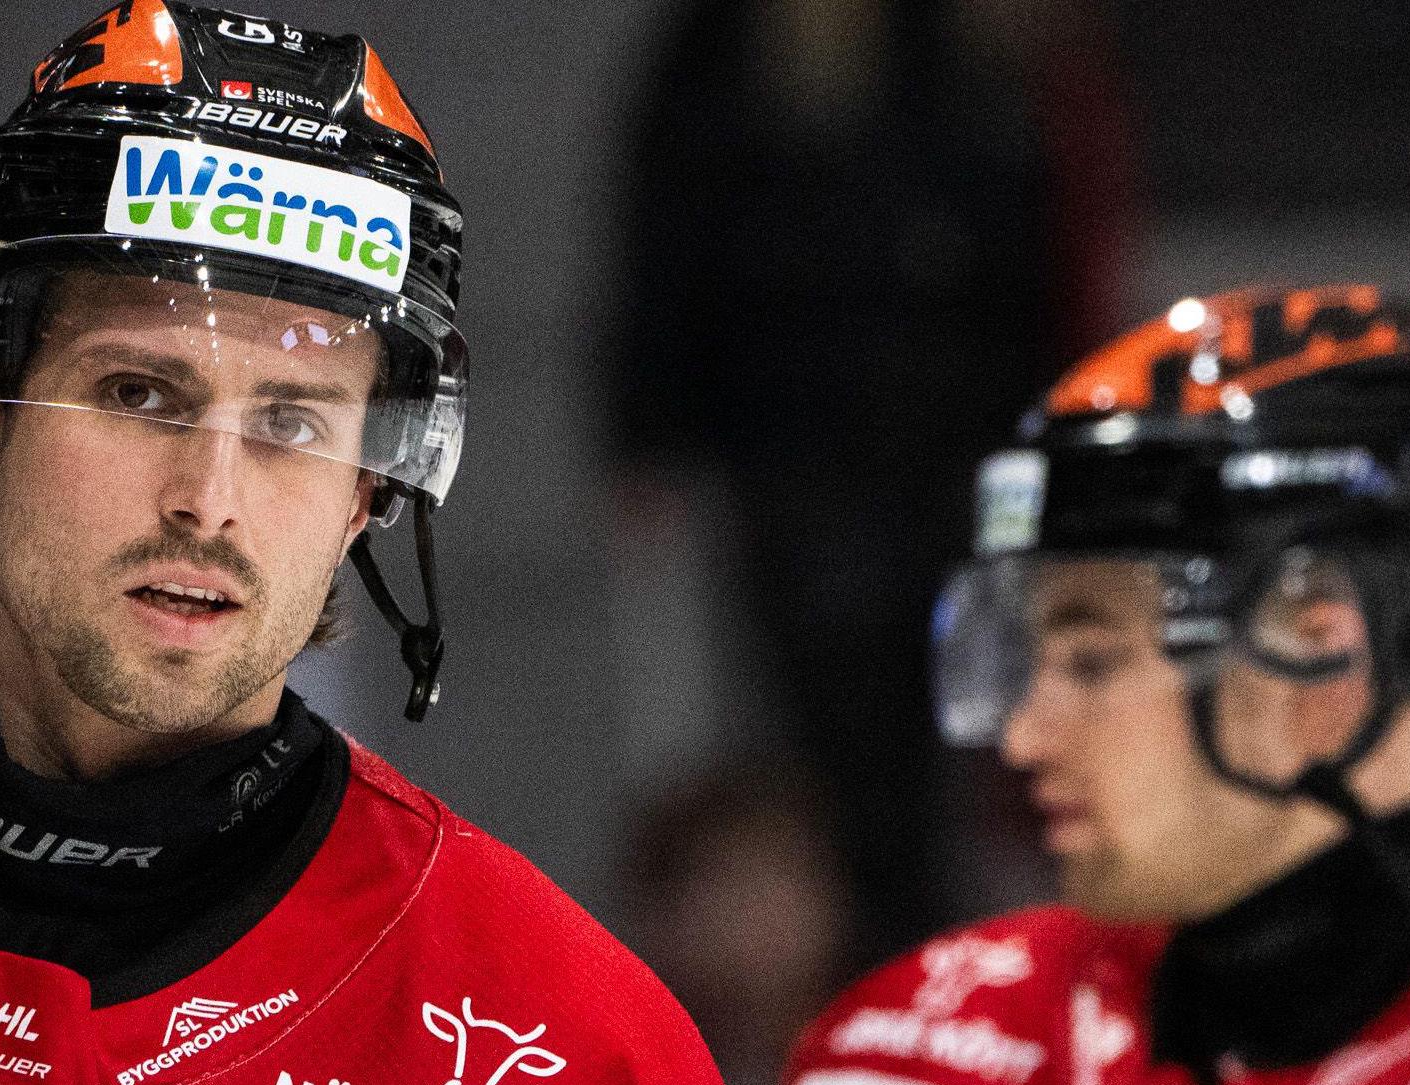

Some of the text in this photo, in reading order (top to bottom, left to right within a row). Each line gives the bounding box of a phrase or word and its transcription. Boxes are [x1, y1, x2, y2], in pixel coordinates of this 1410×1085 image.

[257, 87, 324, 110] SVENSKA
[258, 95, 293, 108] SPEL
[126, 146, 404, 278] Wärna
[175, 1017, 202, 1038] SL
